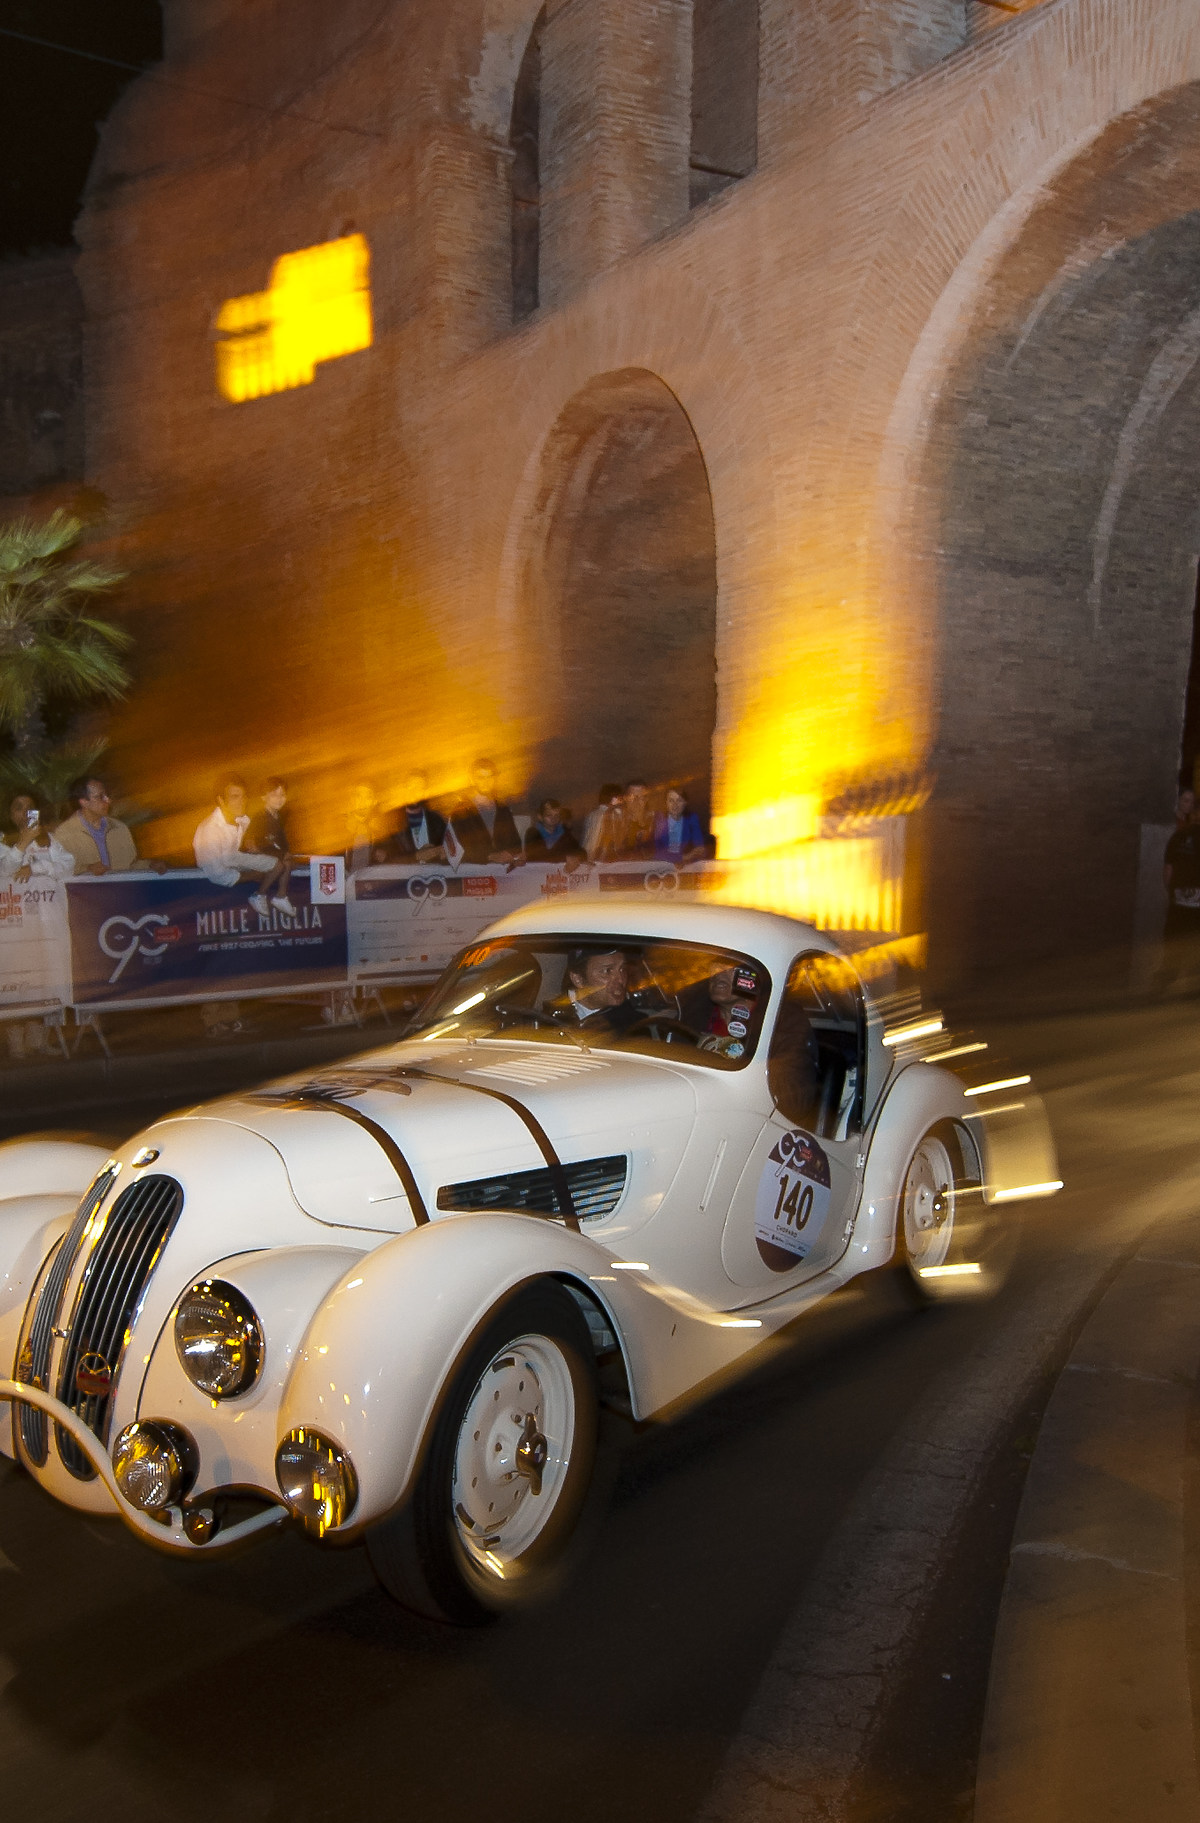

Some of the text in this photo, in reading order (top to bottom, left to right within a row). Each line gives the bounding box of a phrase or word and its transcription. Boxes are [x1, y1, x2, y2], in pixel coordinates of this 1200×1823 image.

[23, 889, 56, 903] 2017
[196, 909, 250, 936] MILLE
[773, 1173, 814, 1231] 140
